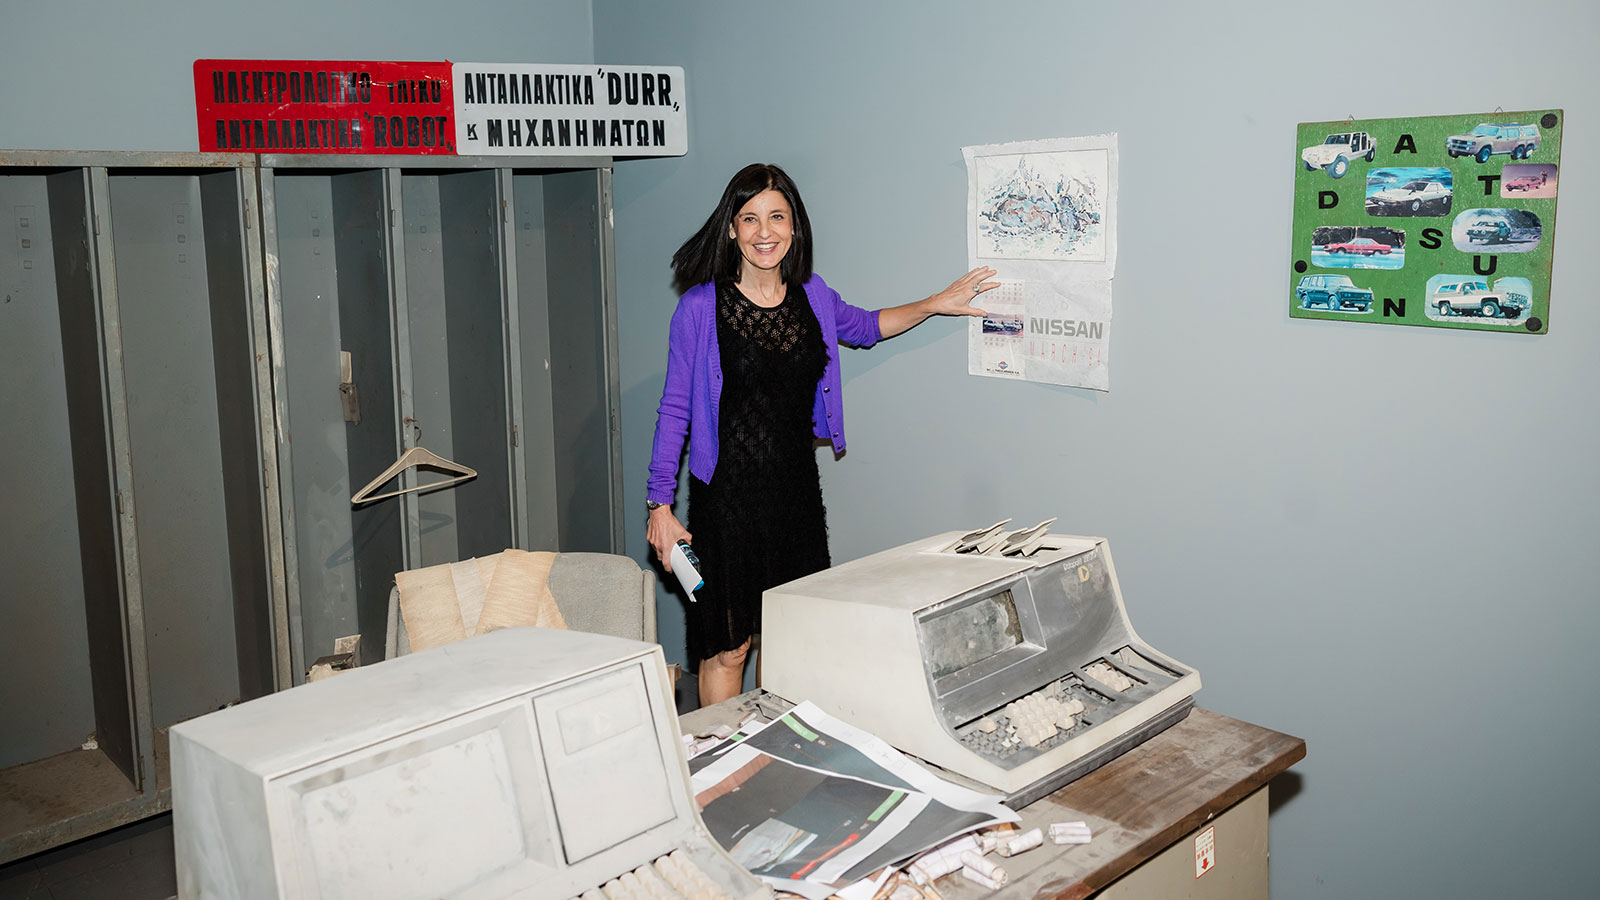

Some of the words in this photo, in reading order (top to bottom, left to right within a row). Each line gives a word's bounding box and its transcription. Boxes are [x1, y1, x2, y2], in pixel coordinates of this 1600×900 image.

[465, 72, 594, 105] ΑΝΤΑΛΛΑΚΤΙΚΑ
[215, 119, 363, 149] ΑΝΤΑΛΛΑΚΤΙΚΑ
[487, 119, 666, 147] ΜΗΧΑΝΗΜΑΤΩΝ
[1030, 317, 1103, 340] NISSAN
[1029, 340, 1078, 364] MARCH
